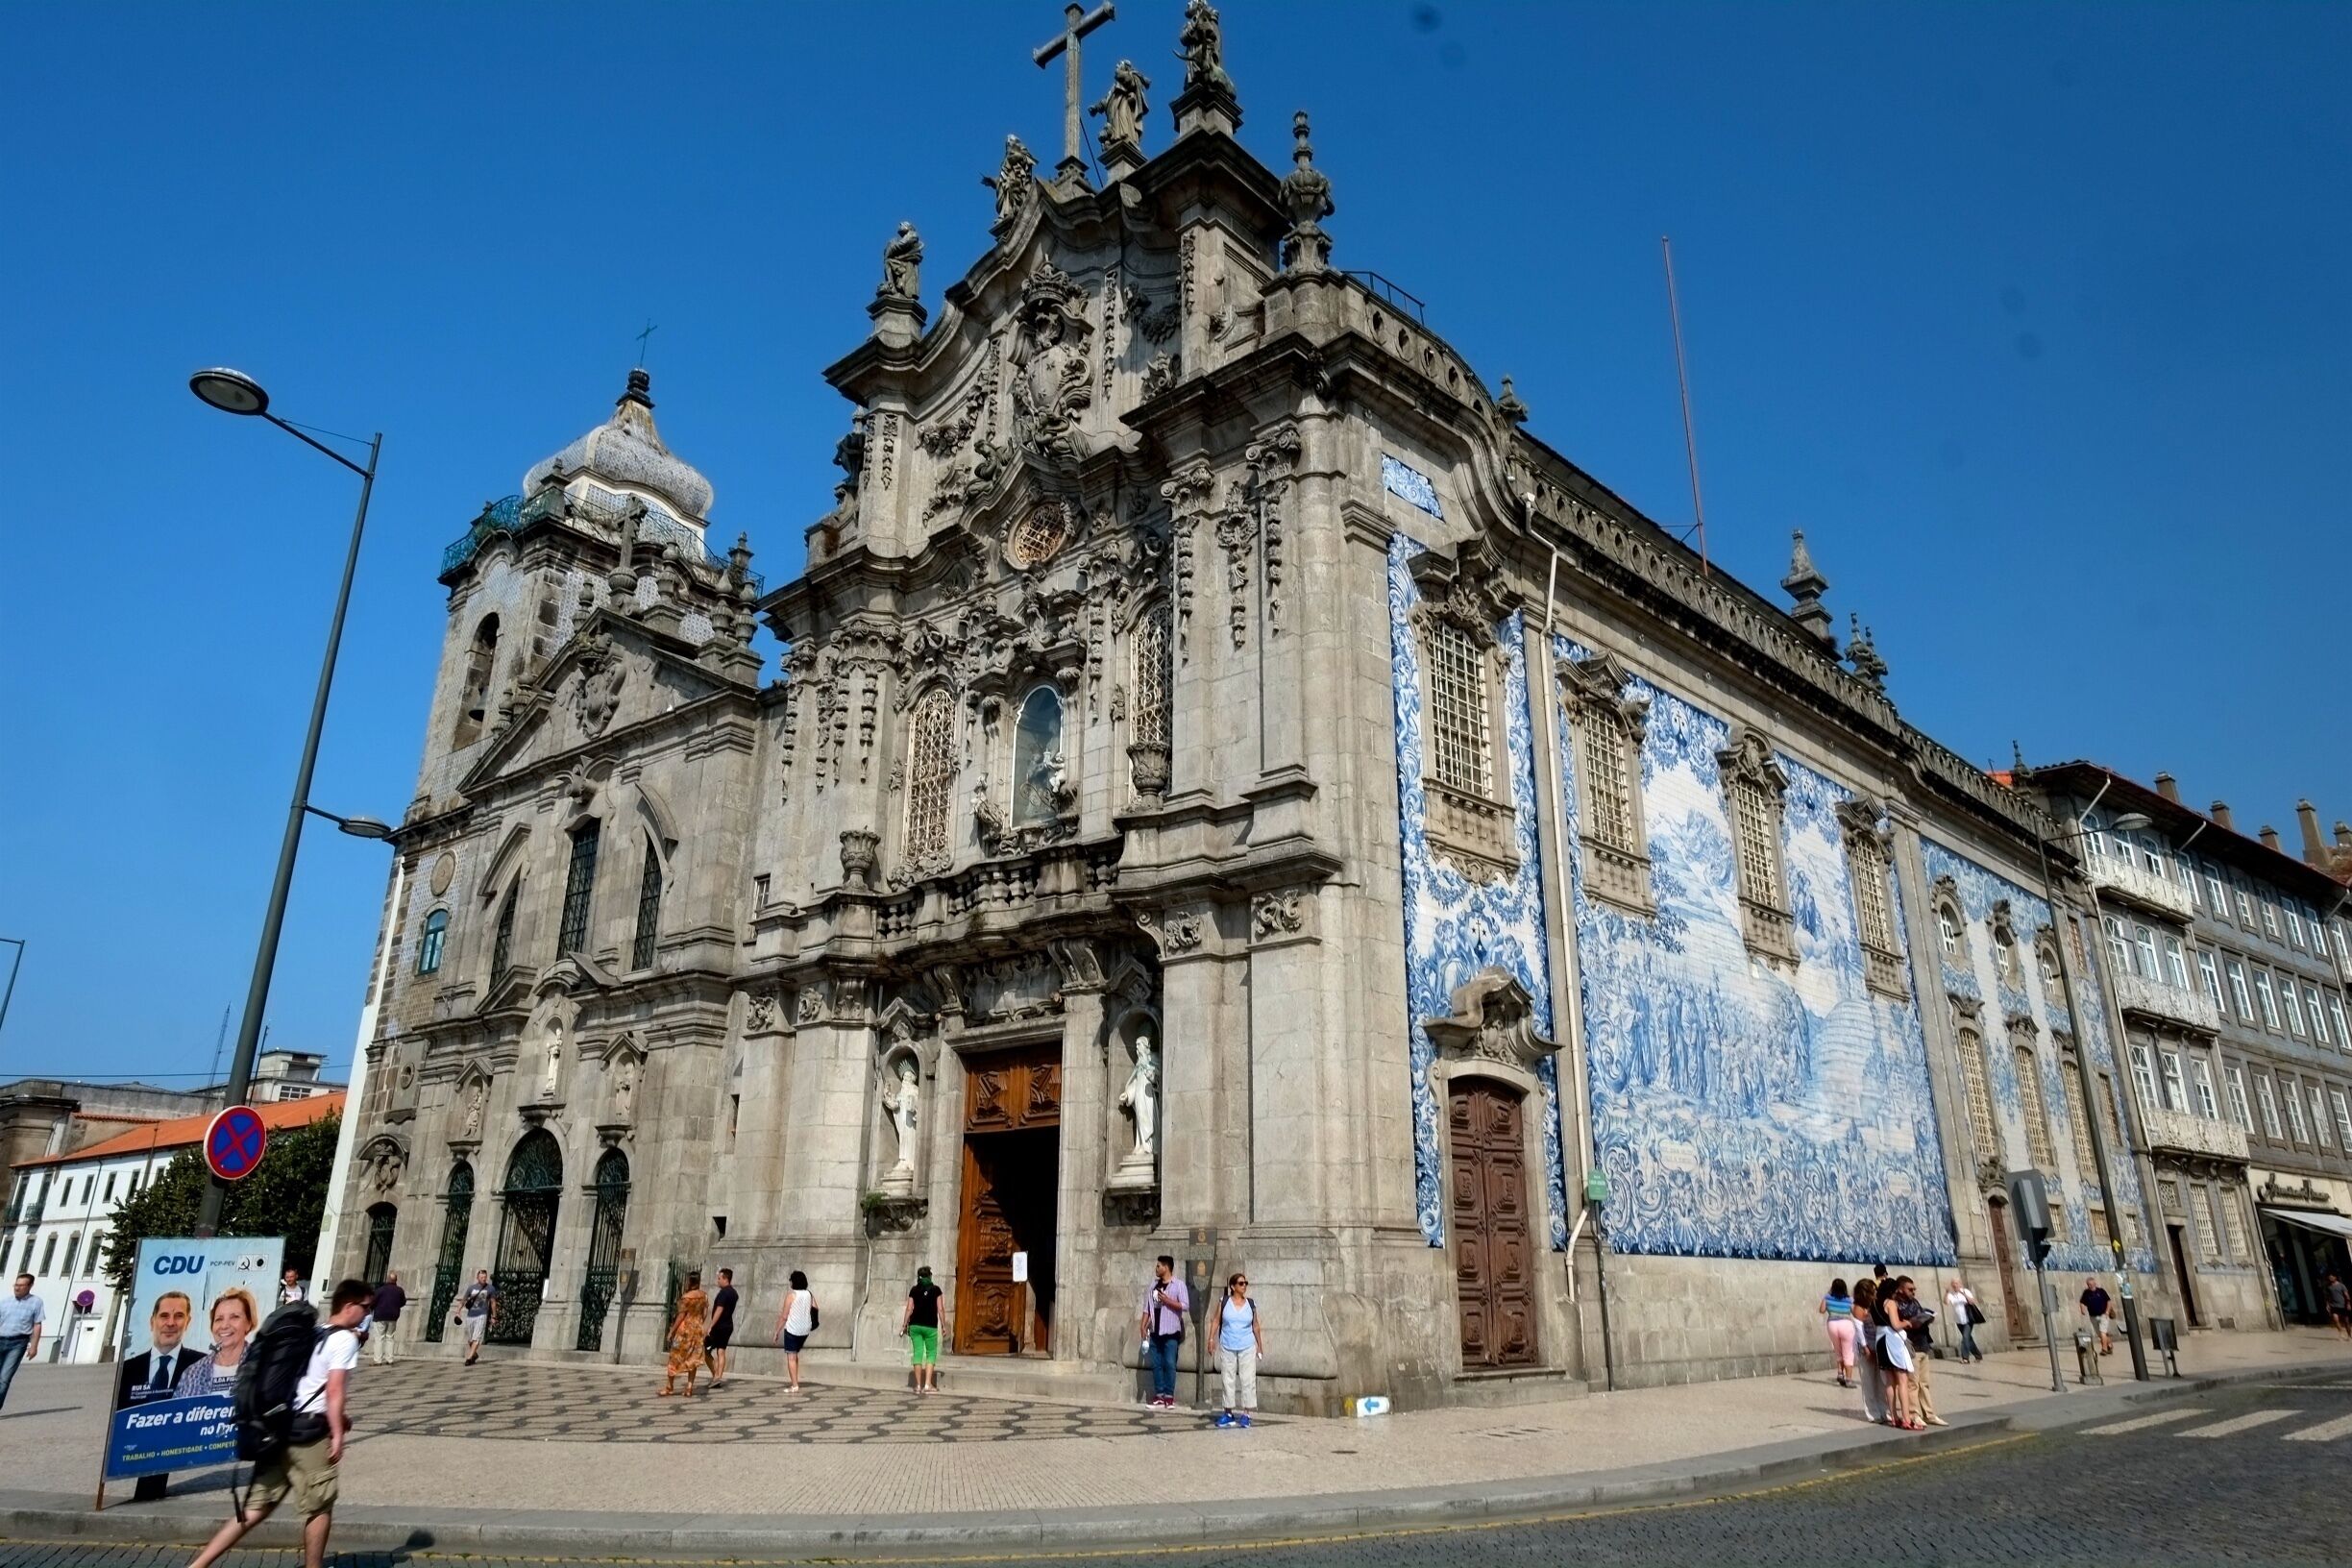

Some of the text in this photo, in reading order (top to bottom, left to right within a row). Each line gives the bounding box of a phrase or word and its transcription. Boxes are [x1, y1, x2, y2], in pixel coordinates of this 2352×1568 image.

[154, 1256, 205, 1275] CDU
[126, 1406, 236, 1429] Fazer a diferen
[200, 1425, 214, 1435] no
[122, 1439, 237, 1461] TRABALHO HONESTIDADE COMPETÊ
